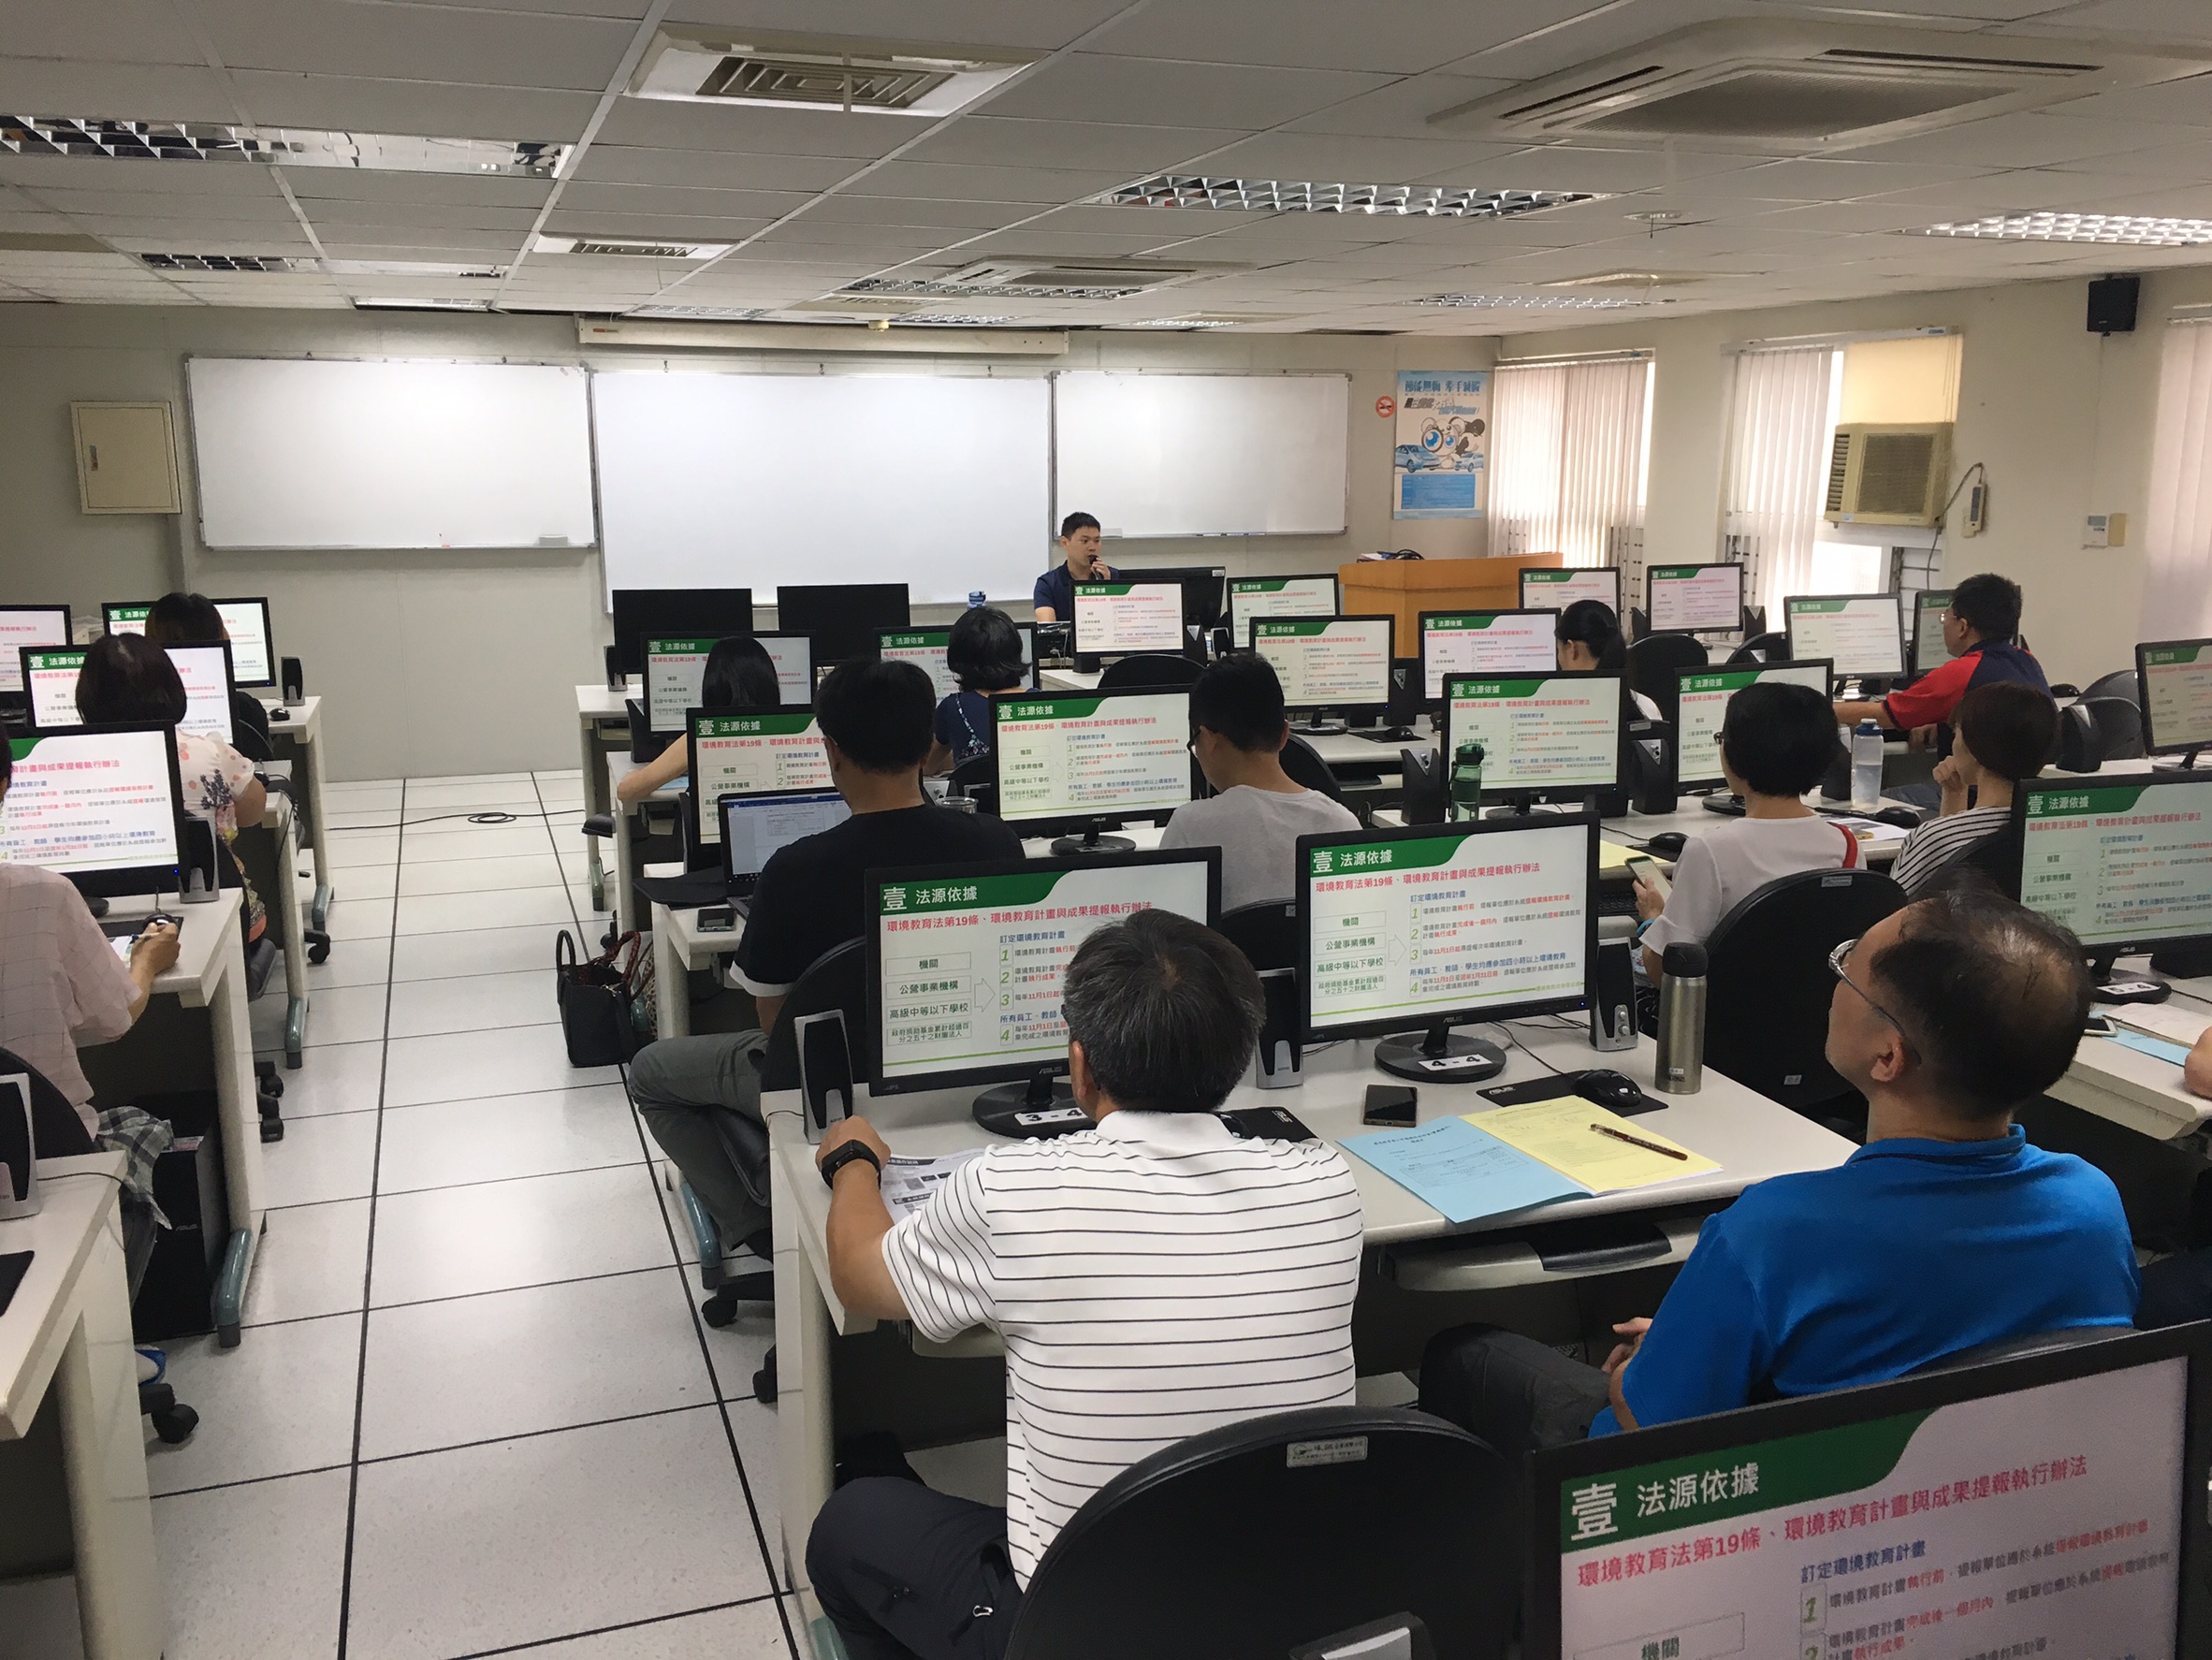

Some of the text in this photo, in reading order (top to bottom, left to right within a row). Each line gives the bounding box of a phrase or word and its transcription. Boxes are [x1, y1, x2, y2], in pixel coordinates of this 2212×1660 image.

[648, 641, 662, 653] 壹
[30, 655, 45, 669] 壹
[1452, 683, 1501, 697] 壹 法源依據
[1680, 677, 1692, 692] 壹
[998, 705, 1054, 720] 壹 法源依據
[698, 719, 761, 735] 壹 法源依據
[2027, 794, 2089, 815] 壹 法源依據
[1312, 849, 1393, 874] 壹 法源依據
[1315, 862, 1541, 893] 環境教育法第19條、環境教育計畫與成果提報執行辦法
[882, 885, 978, 911] 壹 法源依據
[1409, 890, 1467, 903] 訂定環境教育計畫
[1411, 907, 1419, 920] 1
[1342, 916, 1360, 927] 機關
[999, 930, 1066, 944] 訂定環境教育計畫
[1410, 927, 1419, 940] 2
[1325, 936, 1375, 951] 公營事業機構
[1000, 949, 1010, 962] 1
[1410, 949, 1419, 961] 3
[918, 958, 939, 969] 機關
[1317, 956, 1384, 974] 高級中等以下學校
[999, 971, 1011, 984] 2
[898, 980, 959, 996] 公營事業機構
[1409, 982, 1419, 994] 4
[1000, 994, 1010, 1007] 3
[889, 1002, 969, 1020] 高級中等以下學校
[1000, 1028, 1011, 1041] 4
[1570, 1462, 1760, 1541] 壹 法源依據
[1577, 1454, 2088, 1588] 環境教育法第19條、環境教育計畫與成果提報執行辦法
[1800, 1538, 1927, 1584] 訂定環境教育計畫
[1802, 1596, 1817, 1624] 1
[1640, 1636, 1681, 1660] 機關
